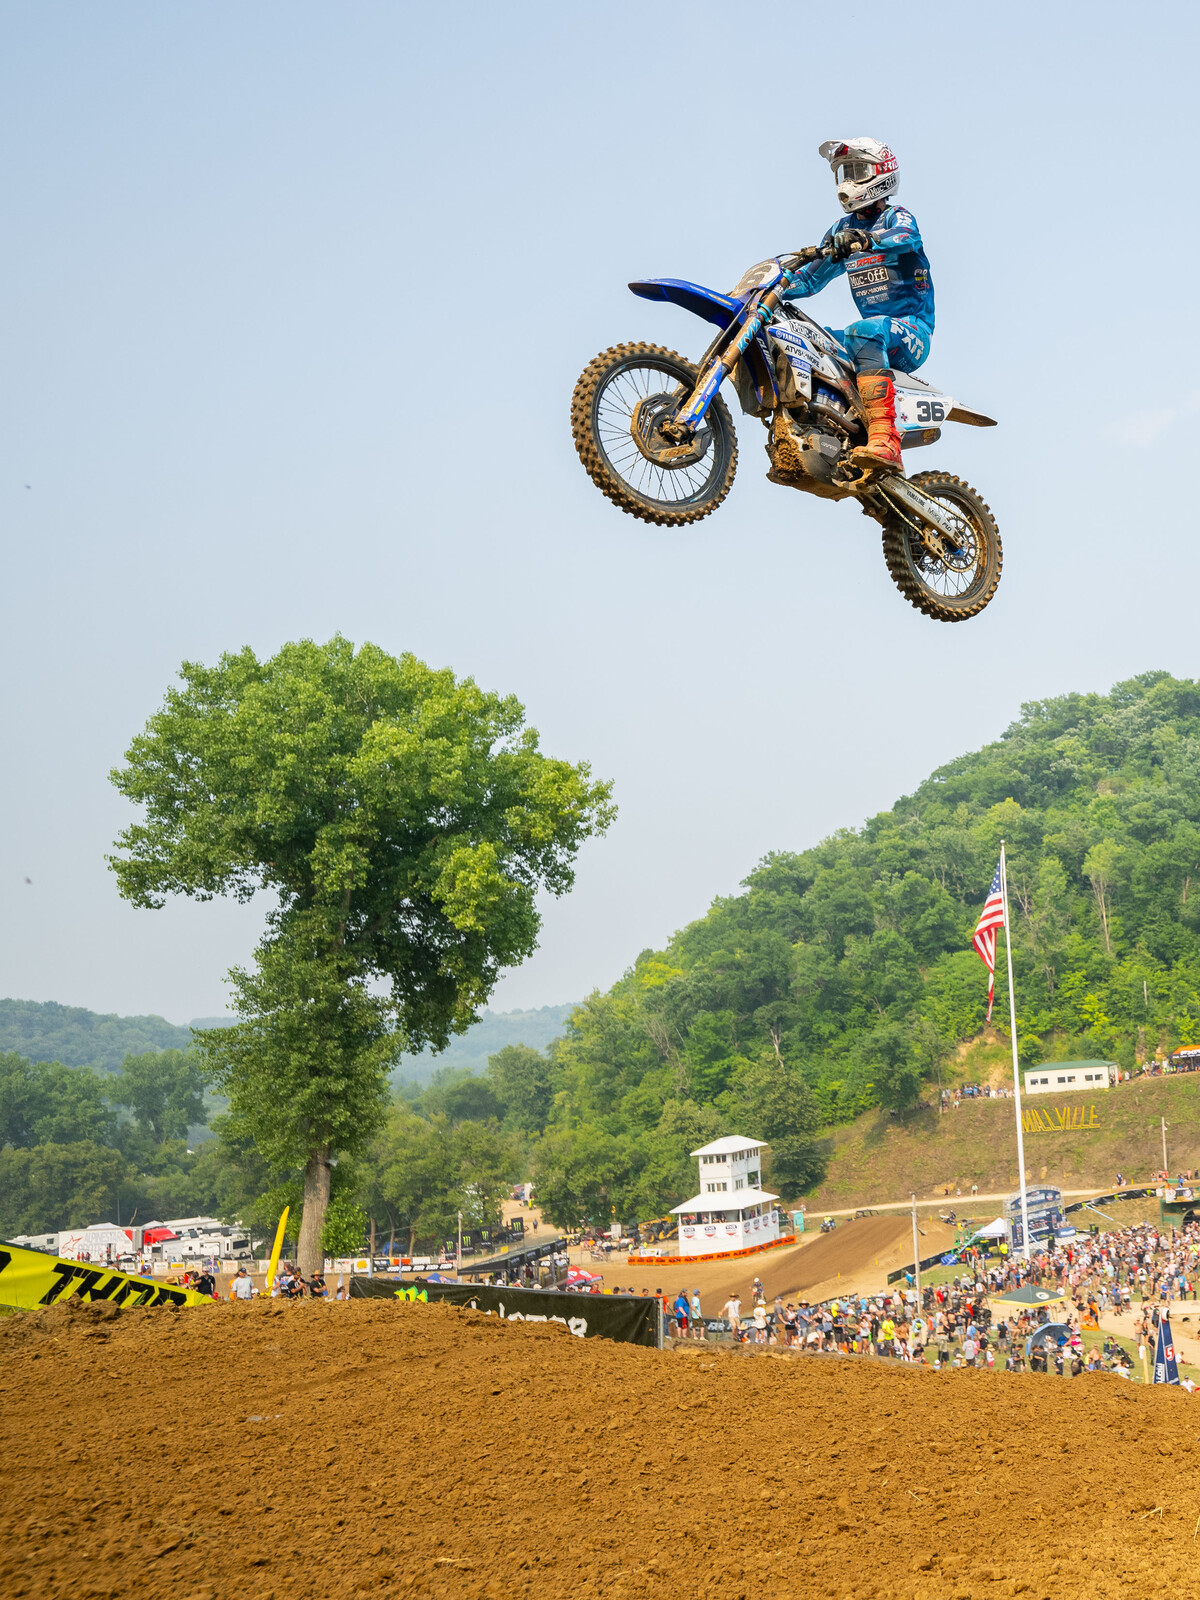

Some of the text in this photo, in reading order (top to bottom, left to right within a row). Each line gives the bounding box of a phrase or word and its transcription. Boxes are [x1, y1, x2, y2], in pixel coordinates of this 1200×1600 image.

[869, 174, 896, 197] Muc-Off
[850, 268, 886, 287] Muc-Off
[781, 331, 803, 346] YAMAHA
[916, 400, 946, 423] 36
[1020, 1105, 1101, 1133] MILLVILLE
